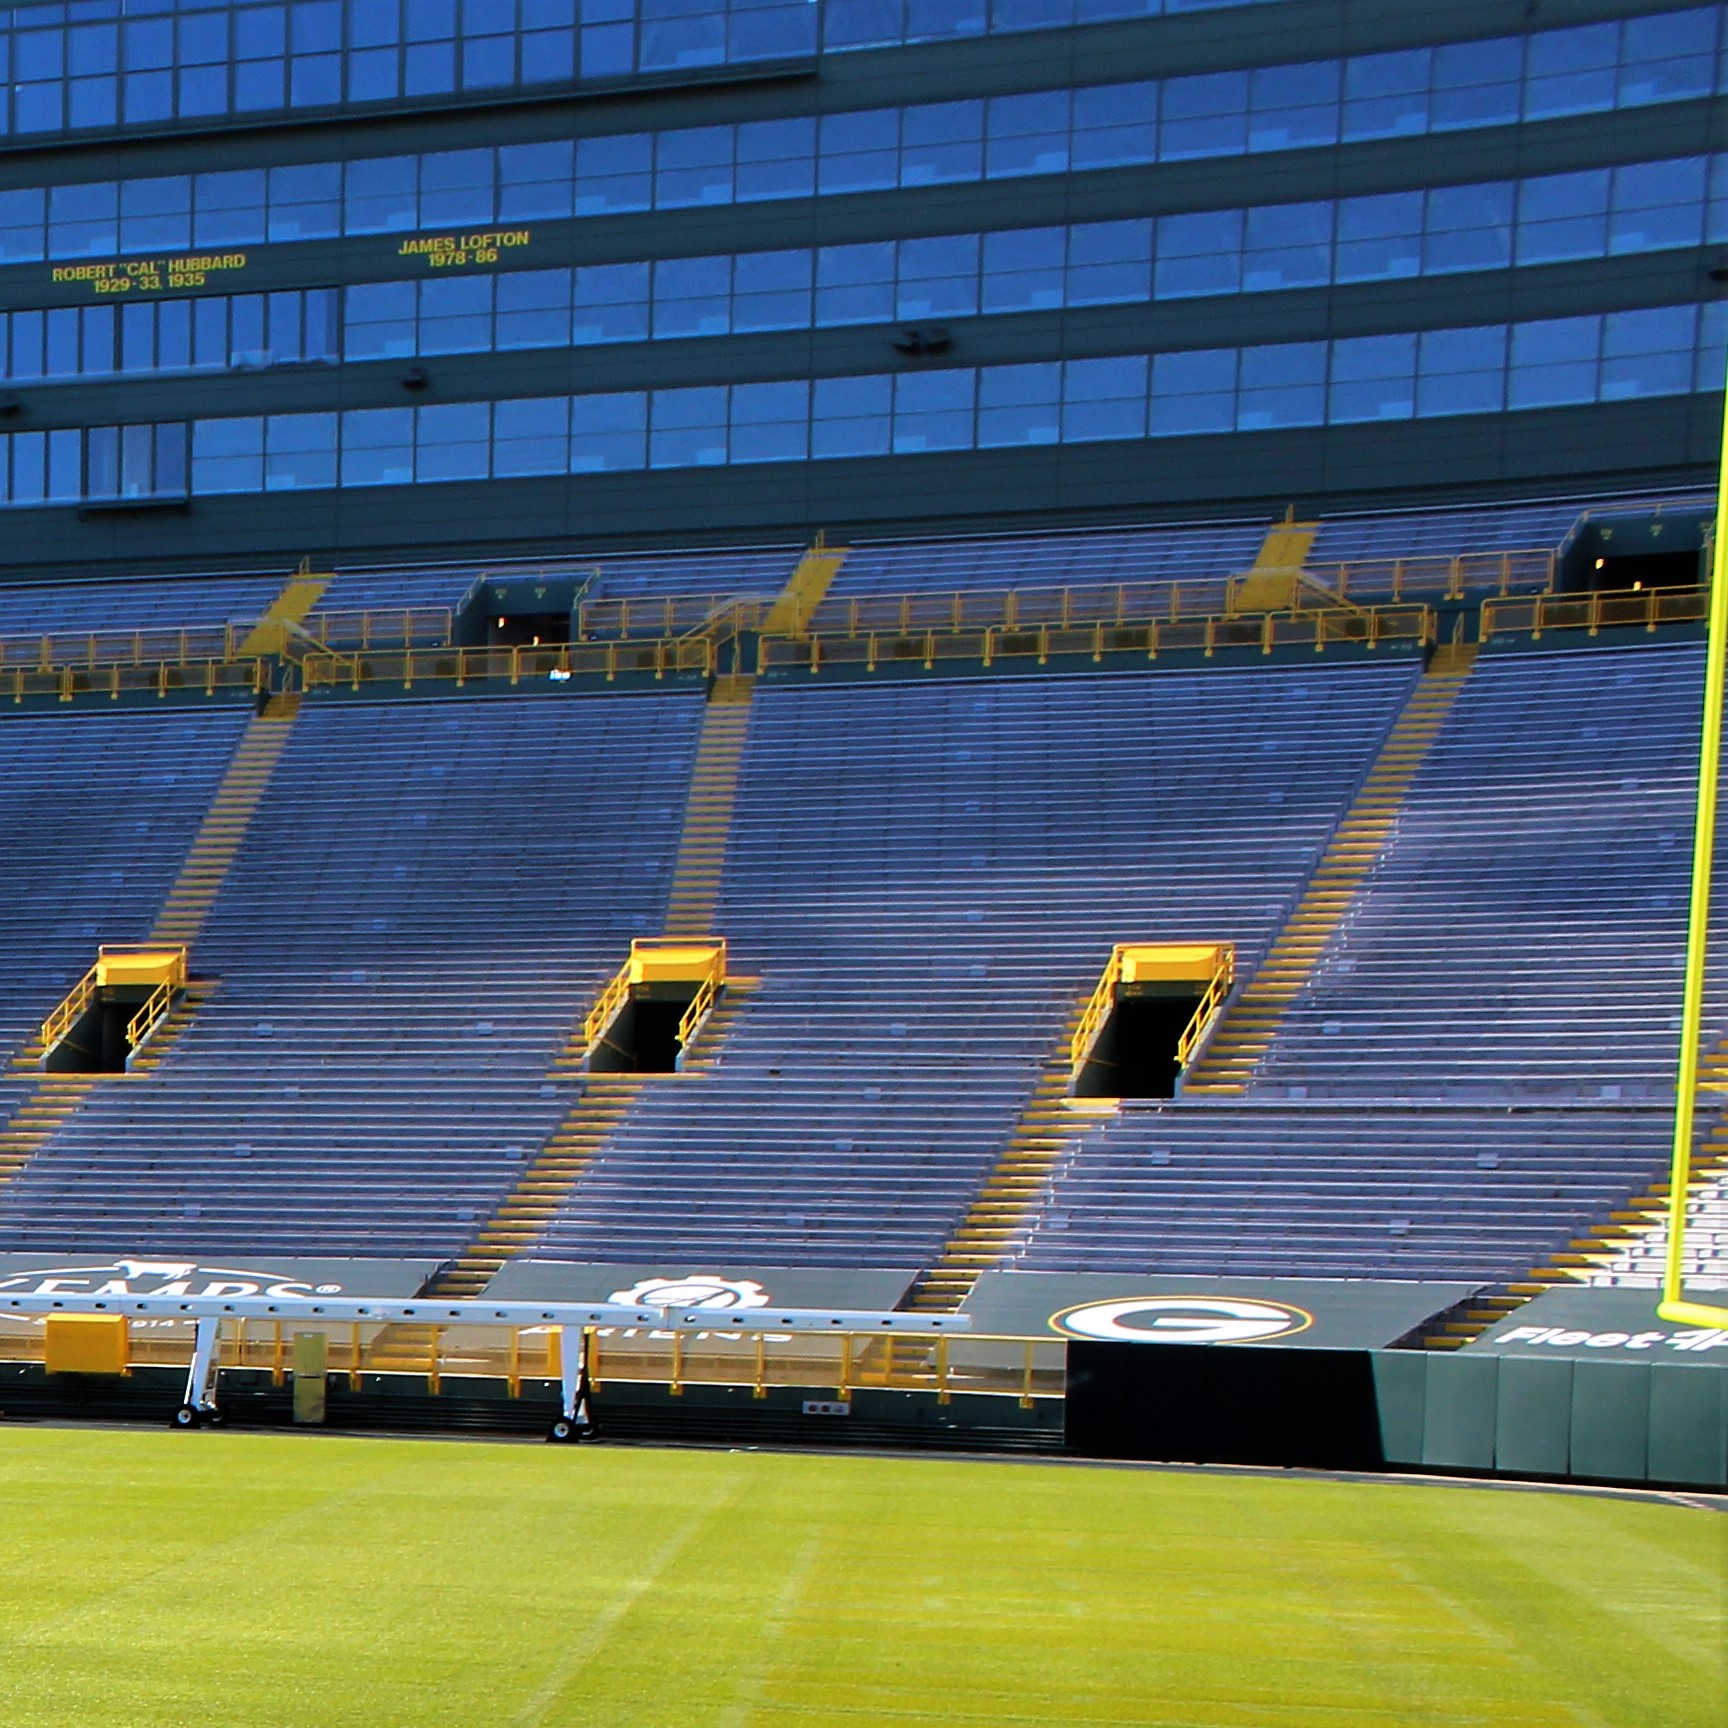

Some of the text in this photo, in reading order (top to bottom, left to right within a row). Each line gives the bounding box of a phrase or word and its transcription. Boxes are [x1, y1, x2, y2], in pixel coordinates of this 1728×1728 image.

[399, 231, 529, 254] JAMES LOFTON
[53, 265, 116, 281] ROBERT
[168, 254, 246, 272] HUBBARD
[168, 272, 206, 287] 1935
[1495, 1326, 1667, 1349] Fleet
